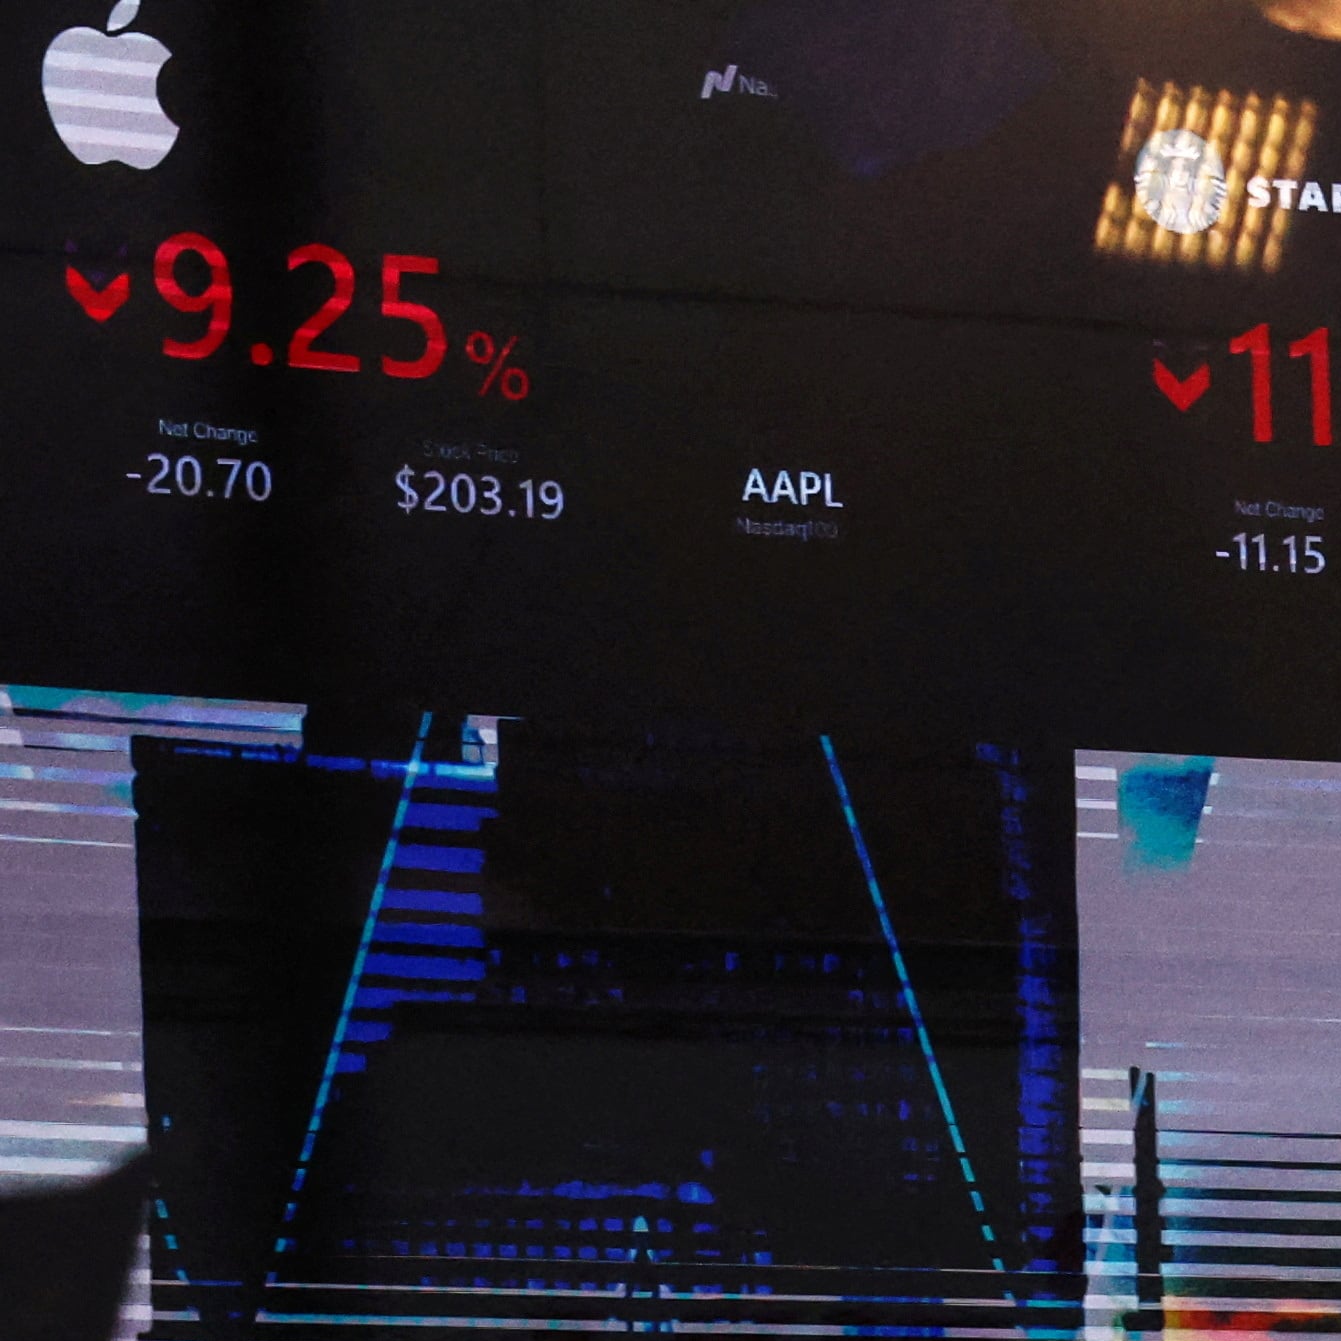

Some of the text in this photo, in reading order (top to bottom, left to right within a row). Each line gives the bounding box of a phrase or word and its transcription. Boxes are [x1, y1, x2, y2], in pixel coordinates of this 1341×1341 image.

[158, 418, 258, 447] Net Change
[125, 451, 273, 502] -20.70
[395, 463, 566, 520] $203.19
[741, 466, 844, 508] AAPL
[1215, 531, 1328, 575] -11.15
